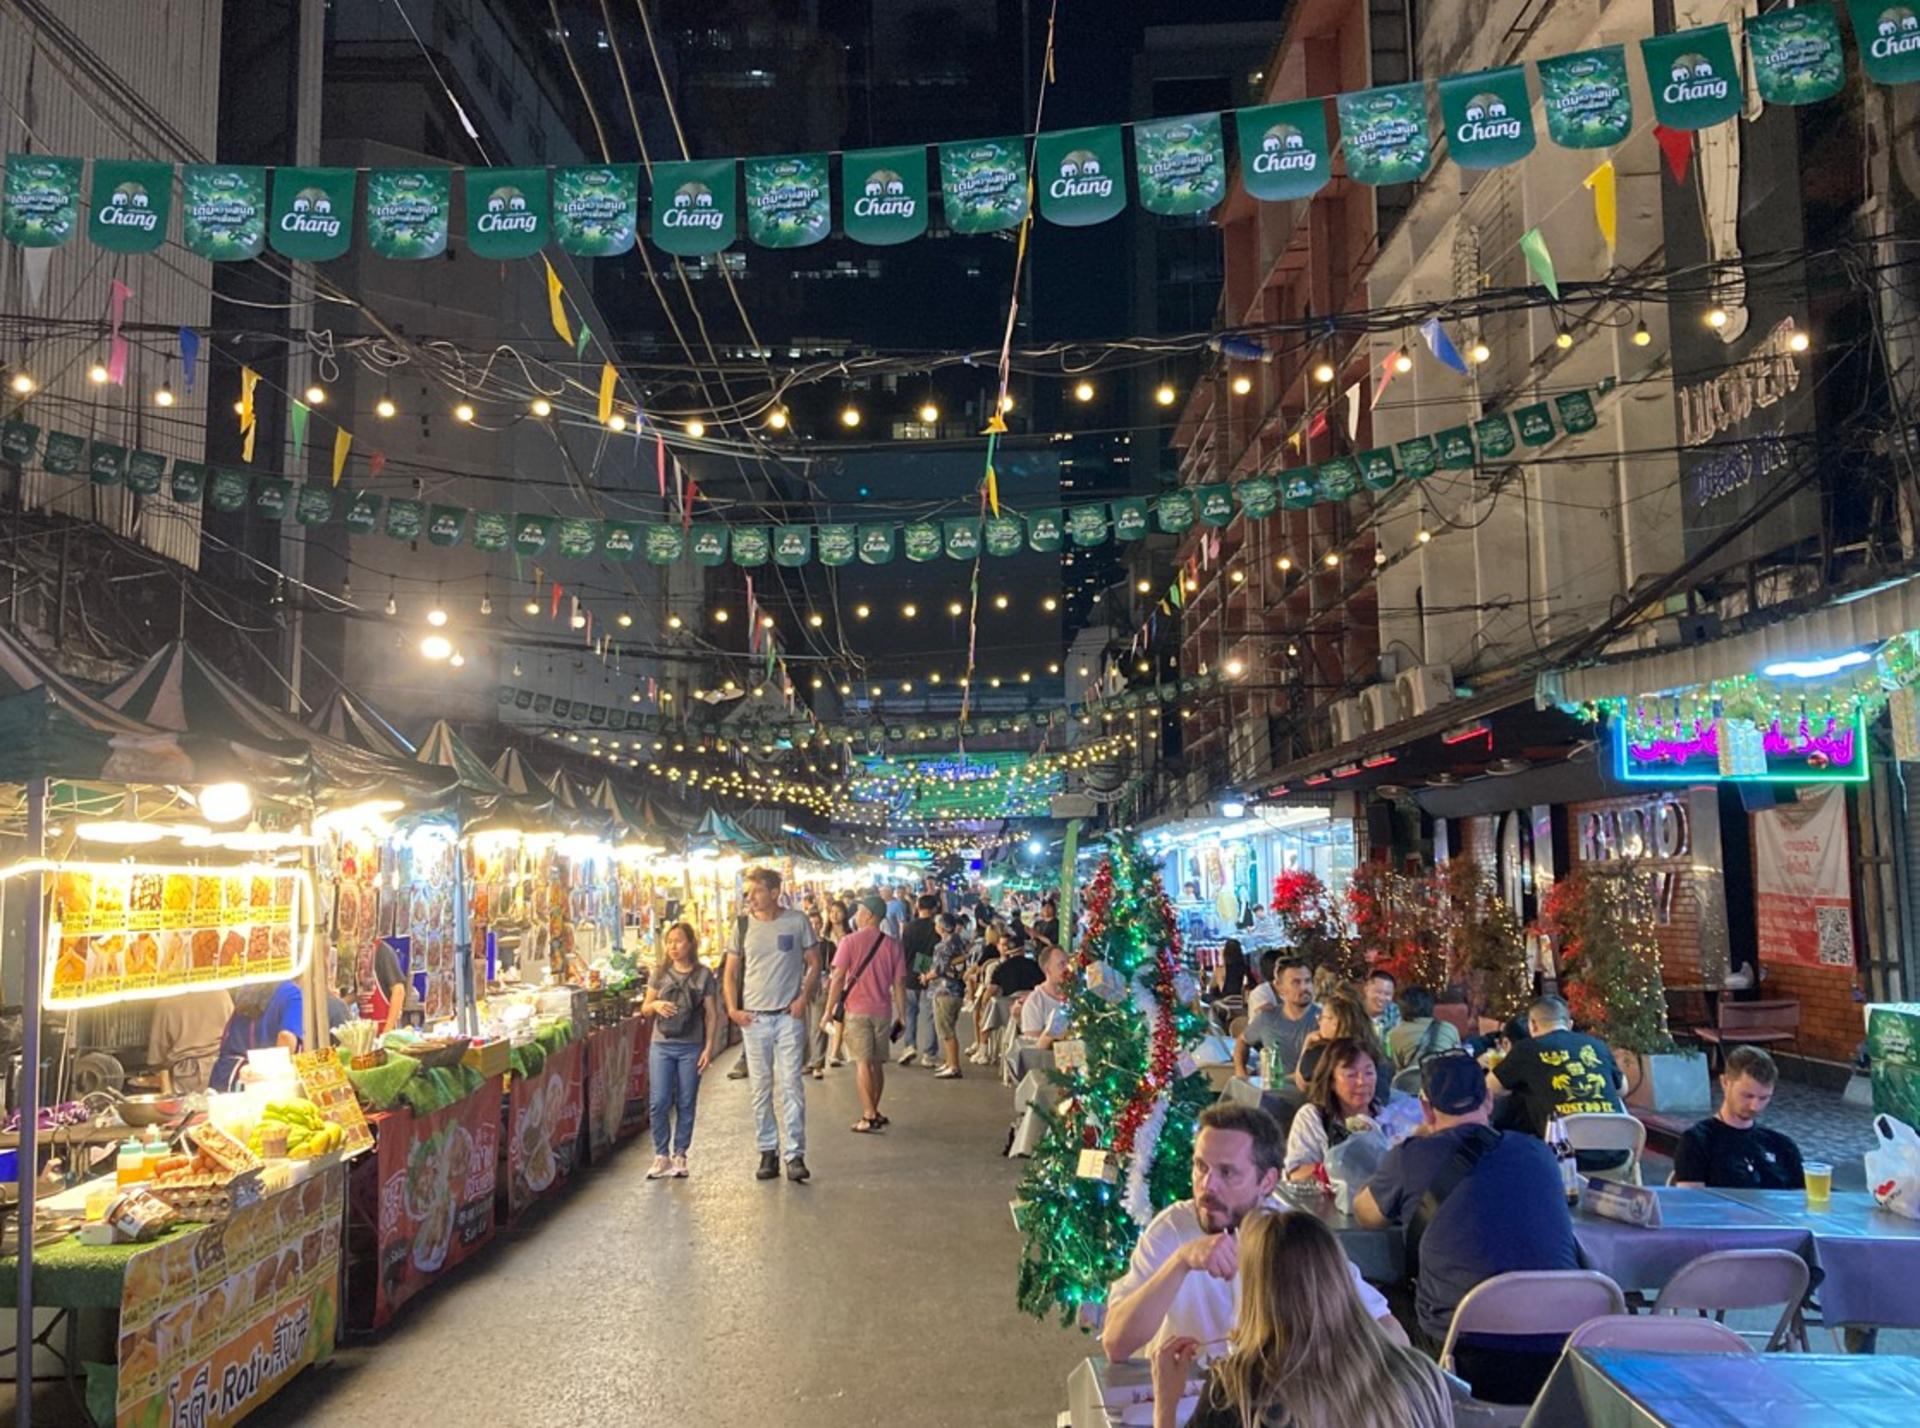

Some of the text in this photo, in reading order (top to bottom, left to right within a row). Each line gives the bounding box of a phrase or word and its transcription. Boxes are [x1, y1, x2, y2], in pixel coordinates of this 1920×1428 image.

[1872, 35, 1920, 58] Chan
[1663, 79, 1727, 103] Chang
[1457, 121, 1520, 142] Chang
[1253, 152, 1317, 173] Chang
[1050, 178, 1113, 198] Chang
[854, 197, 916, 217] Chang
[99, 206, 157, 230] Chang
[281, 212, 340, 236] Chang
[477, 212, 537, 233] Chang
[663, 208, 724, 229] Chang
[221, 1343, 262, 1415] Roti
